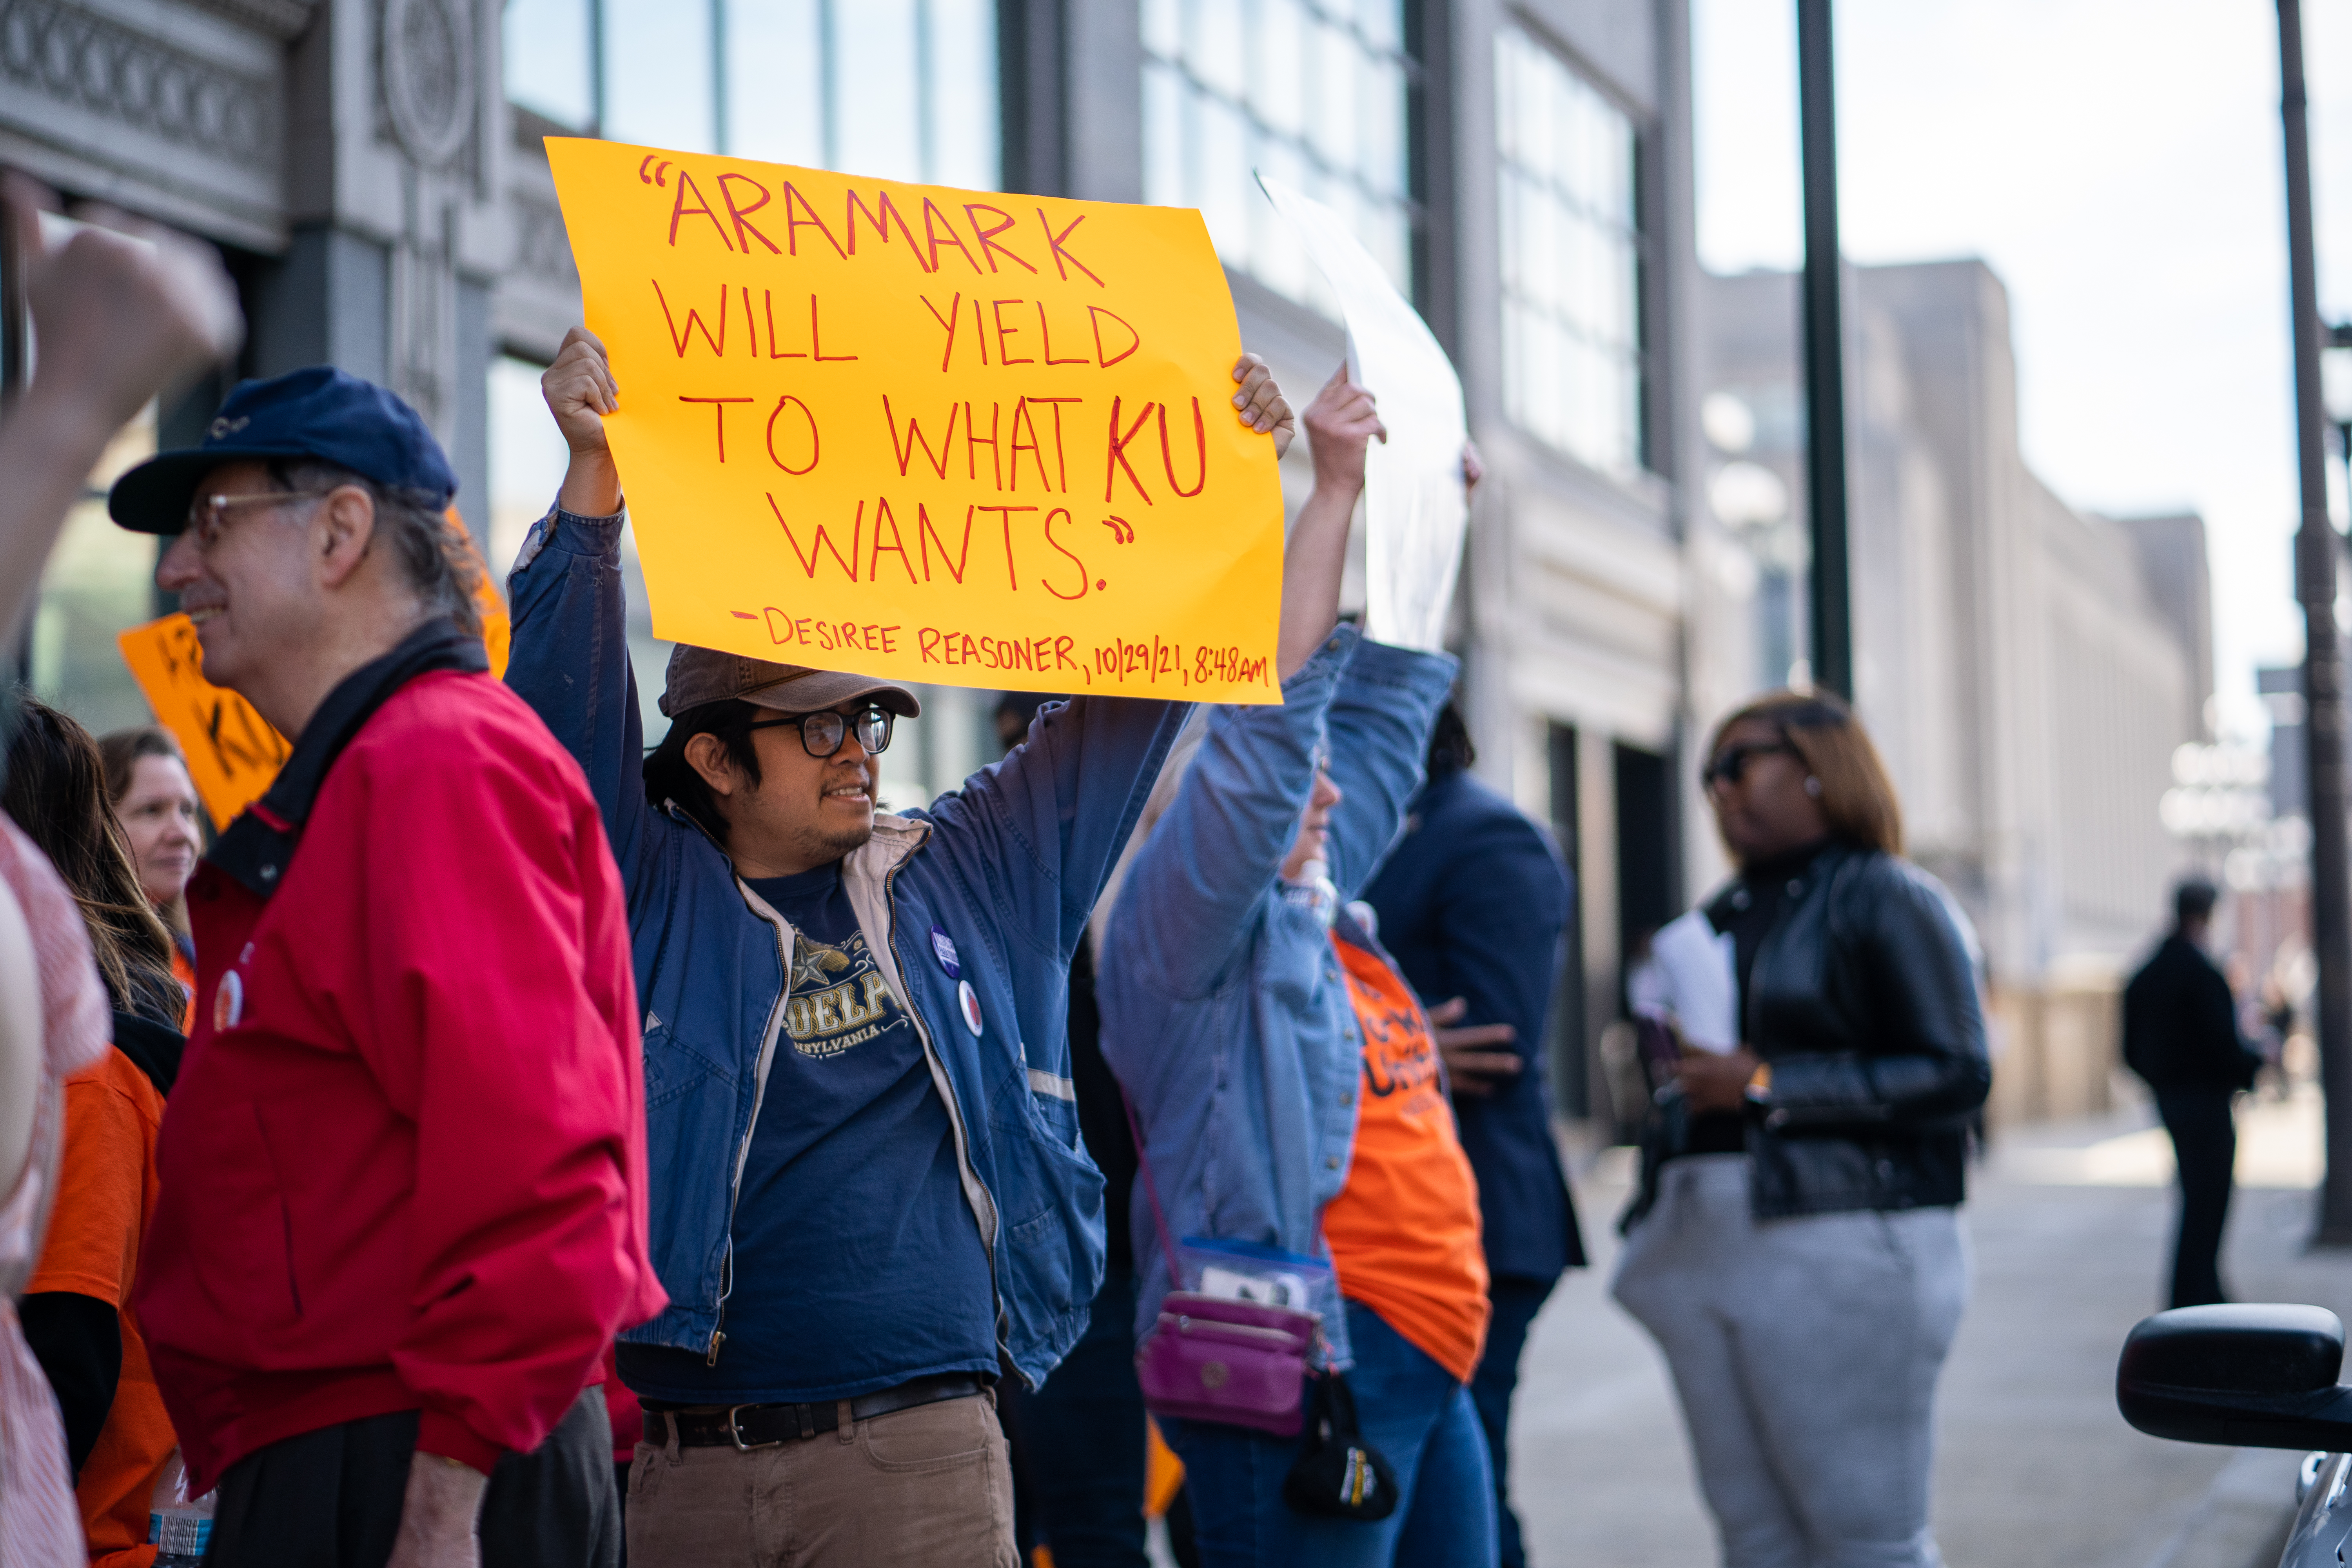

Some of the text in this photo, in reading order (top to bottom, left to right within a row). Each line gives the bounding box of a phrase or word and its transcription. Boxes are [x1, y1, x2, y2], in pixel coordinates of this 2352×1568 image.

[652, 278, 1140, 373] WILL YIELD
[679, 394, 1206, 506] TO WHAT KU
[918, 627, 1091, 685] REASONER,
[784, 970, 903, 1040] DELP
